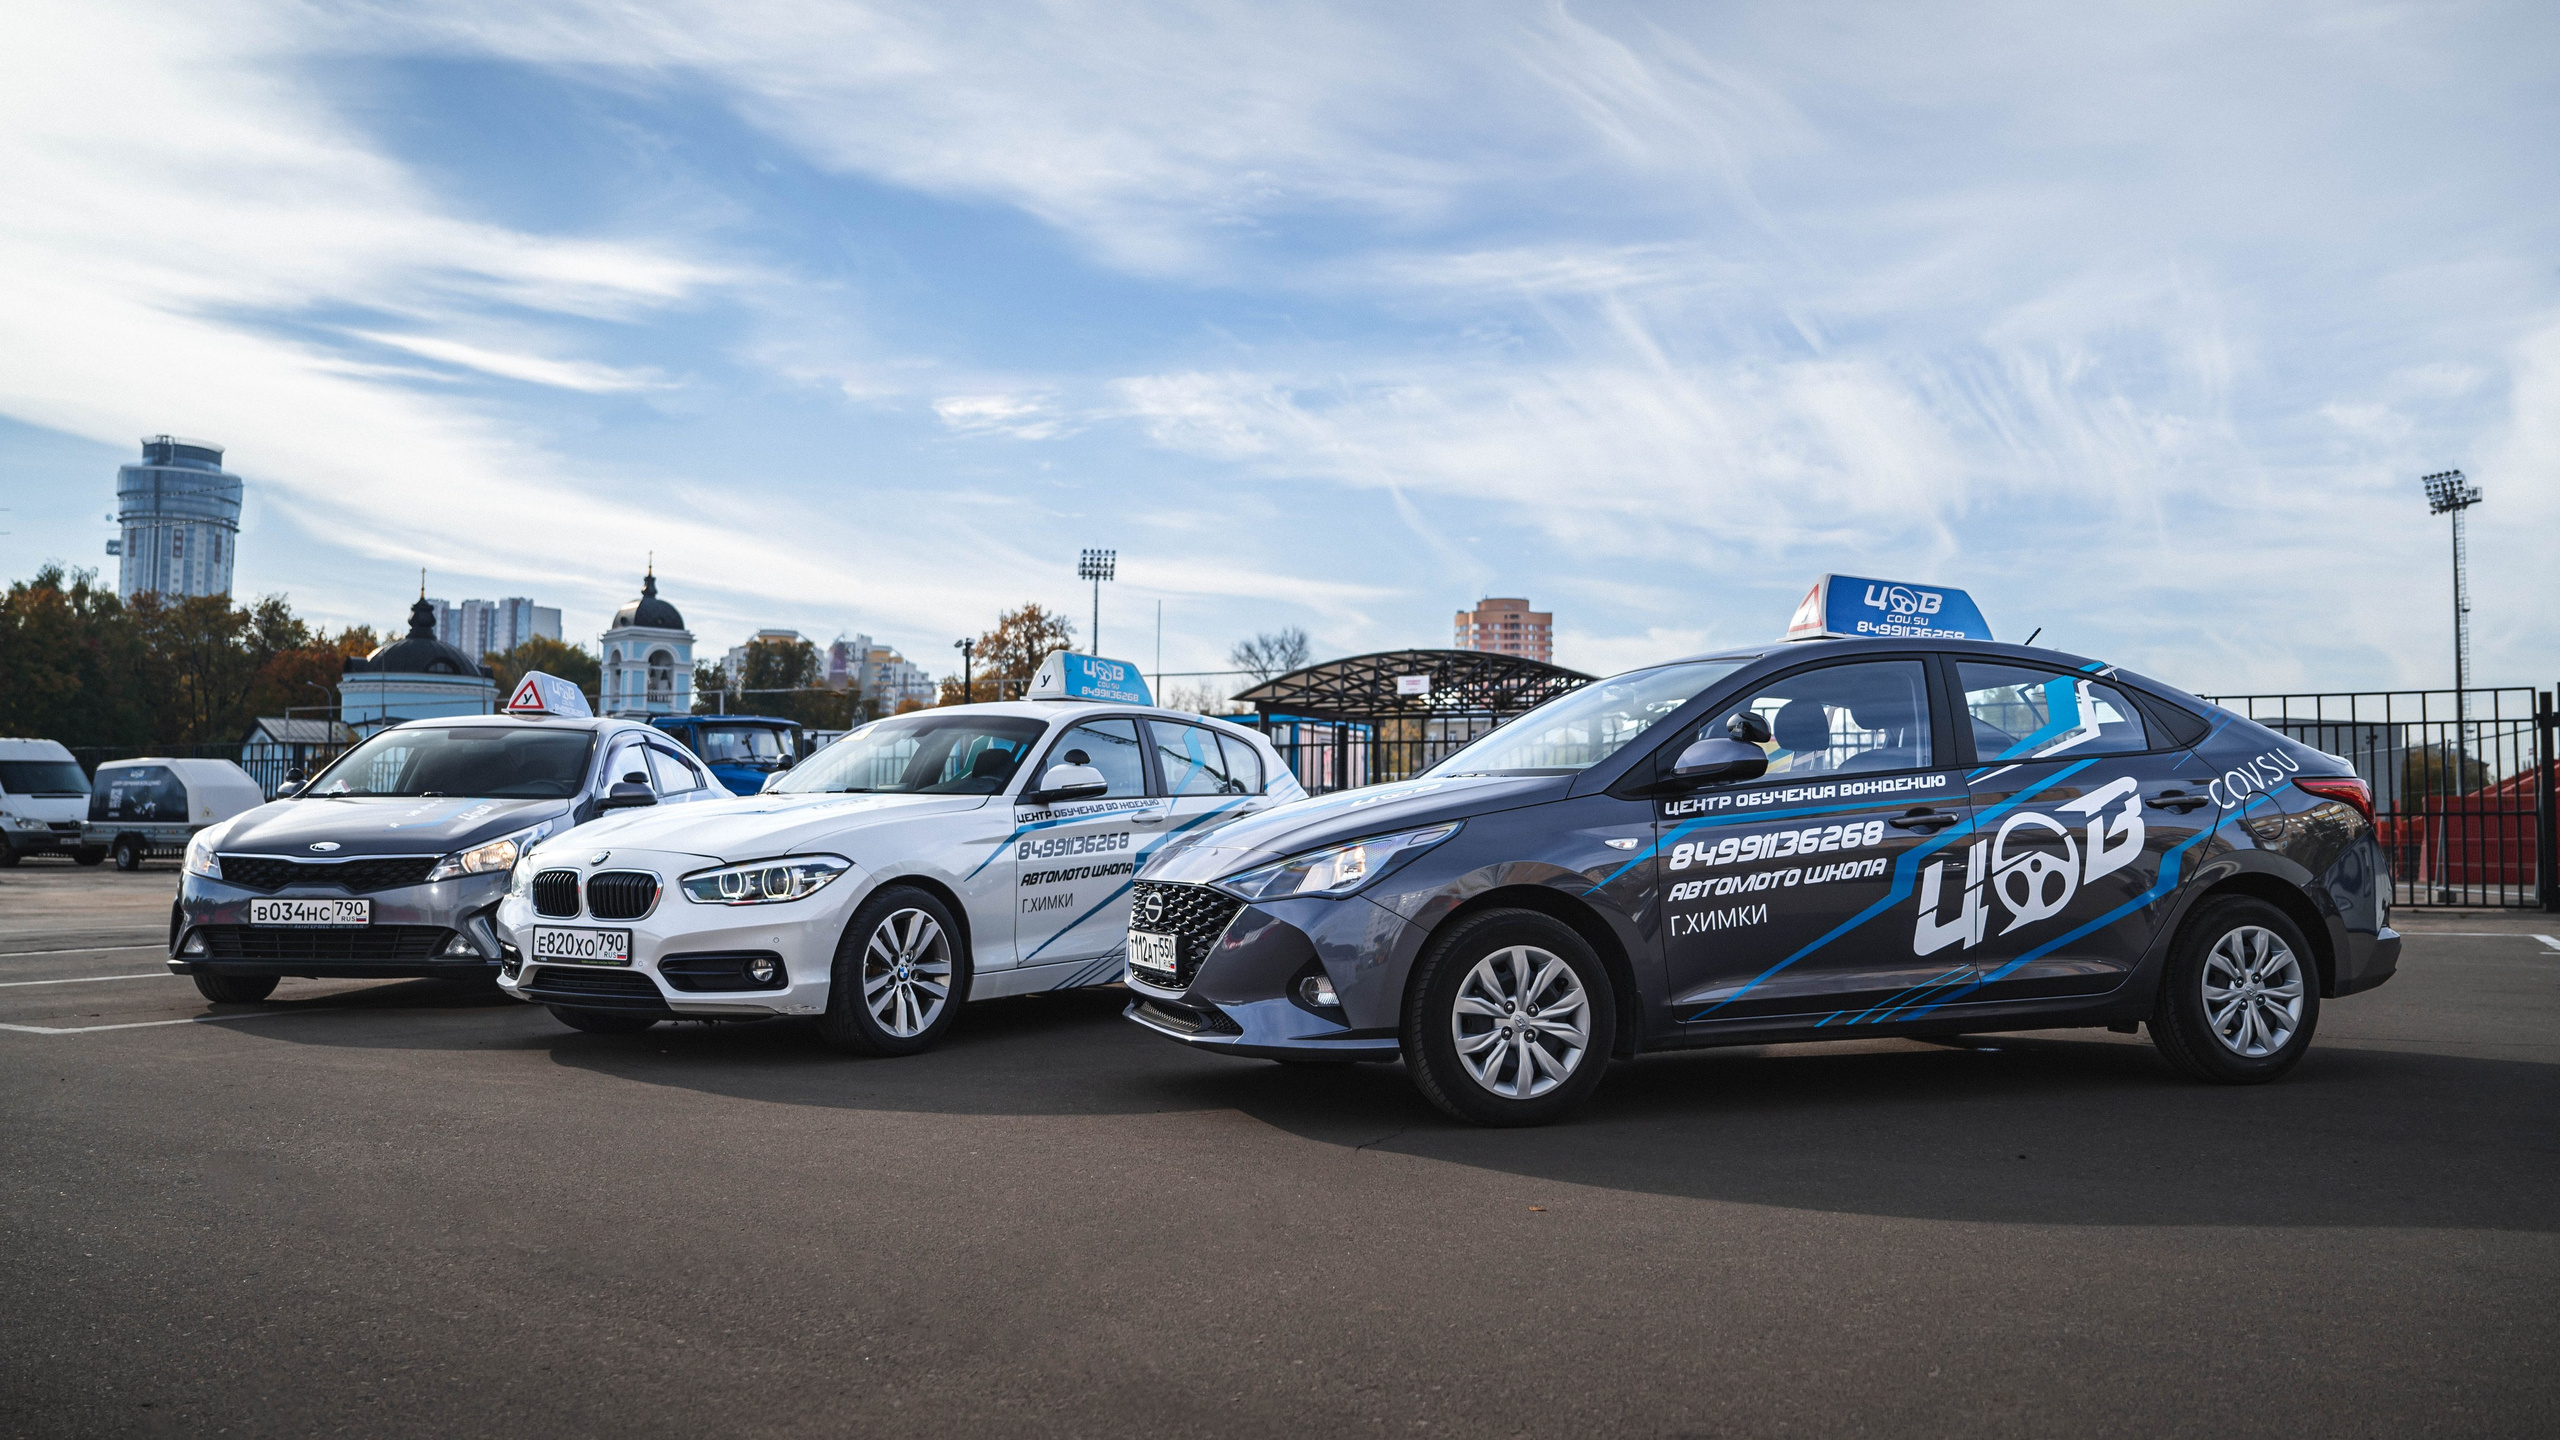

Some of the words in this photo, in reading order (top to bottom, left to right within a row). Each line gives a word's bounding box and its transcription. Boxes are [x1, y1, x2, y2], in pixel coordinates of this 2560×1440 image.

[1857, 621, 1965, 639] 84991136268
[1081, 686, 1139, 701] 84991136268
[2208, 747, 2300, 810] COV.SU
[1665, 795, 1732, 816] ЦЕНТР
[1736, 785, 1836, 807] ОБУЧЕНИЯ
[1840, 774, 1946, 797] ВОЖДЕНИЮ
[1017, 811, 1053, 824] ЦЕНТР
[1054, 804, 1106, 818] ОБУЧЕНИЯ
[1018, 832, 1130, 860] 84991136268
[1668, 820, 1885, 871] 84991136268
[1020, 866, 1091, 887] АВТОМОТО
[1091, 862, 1133, 878] ШКОЛА
[1668, 868, 1802, 902] АВТОМОТО
[1803, 858, 1887, 885] ШКОЛА
[258, 902, 331, 921] В034НС
[335, 901, 364, 916] 790
[1022, 893, 1074, 914] Г.ХИМКИ
[1670, 903, 1768, 937] Г.ХИМКИ
[538, 932, 595, 957] Е820ХО
[598, 933, 624, 952] 790
[603, 951, 617, 959] RUS
